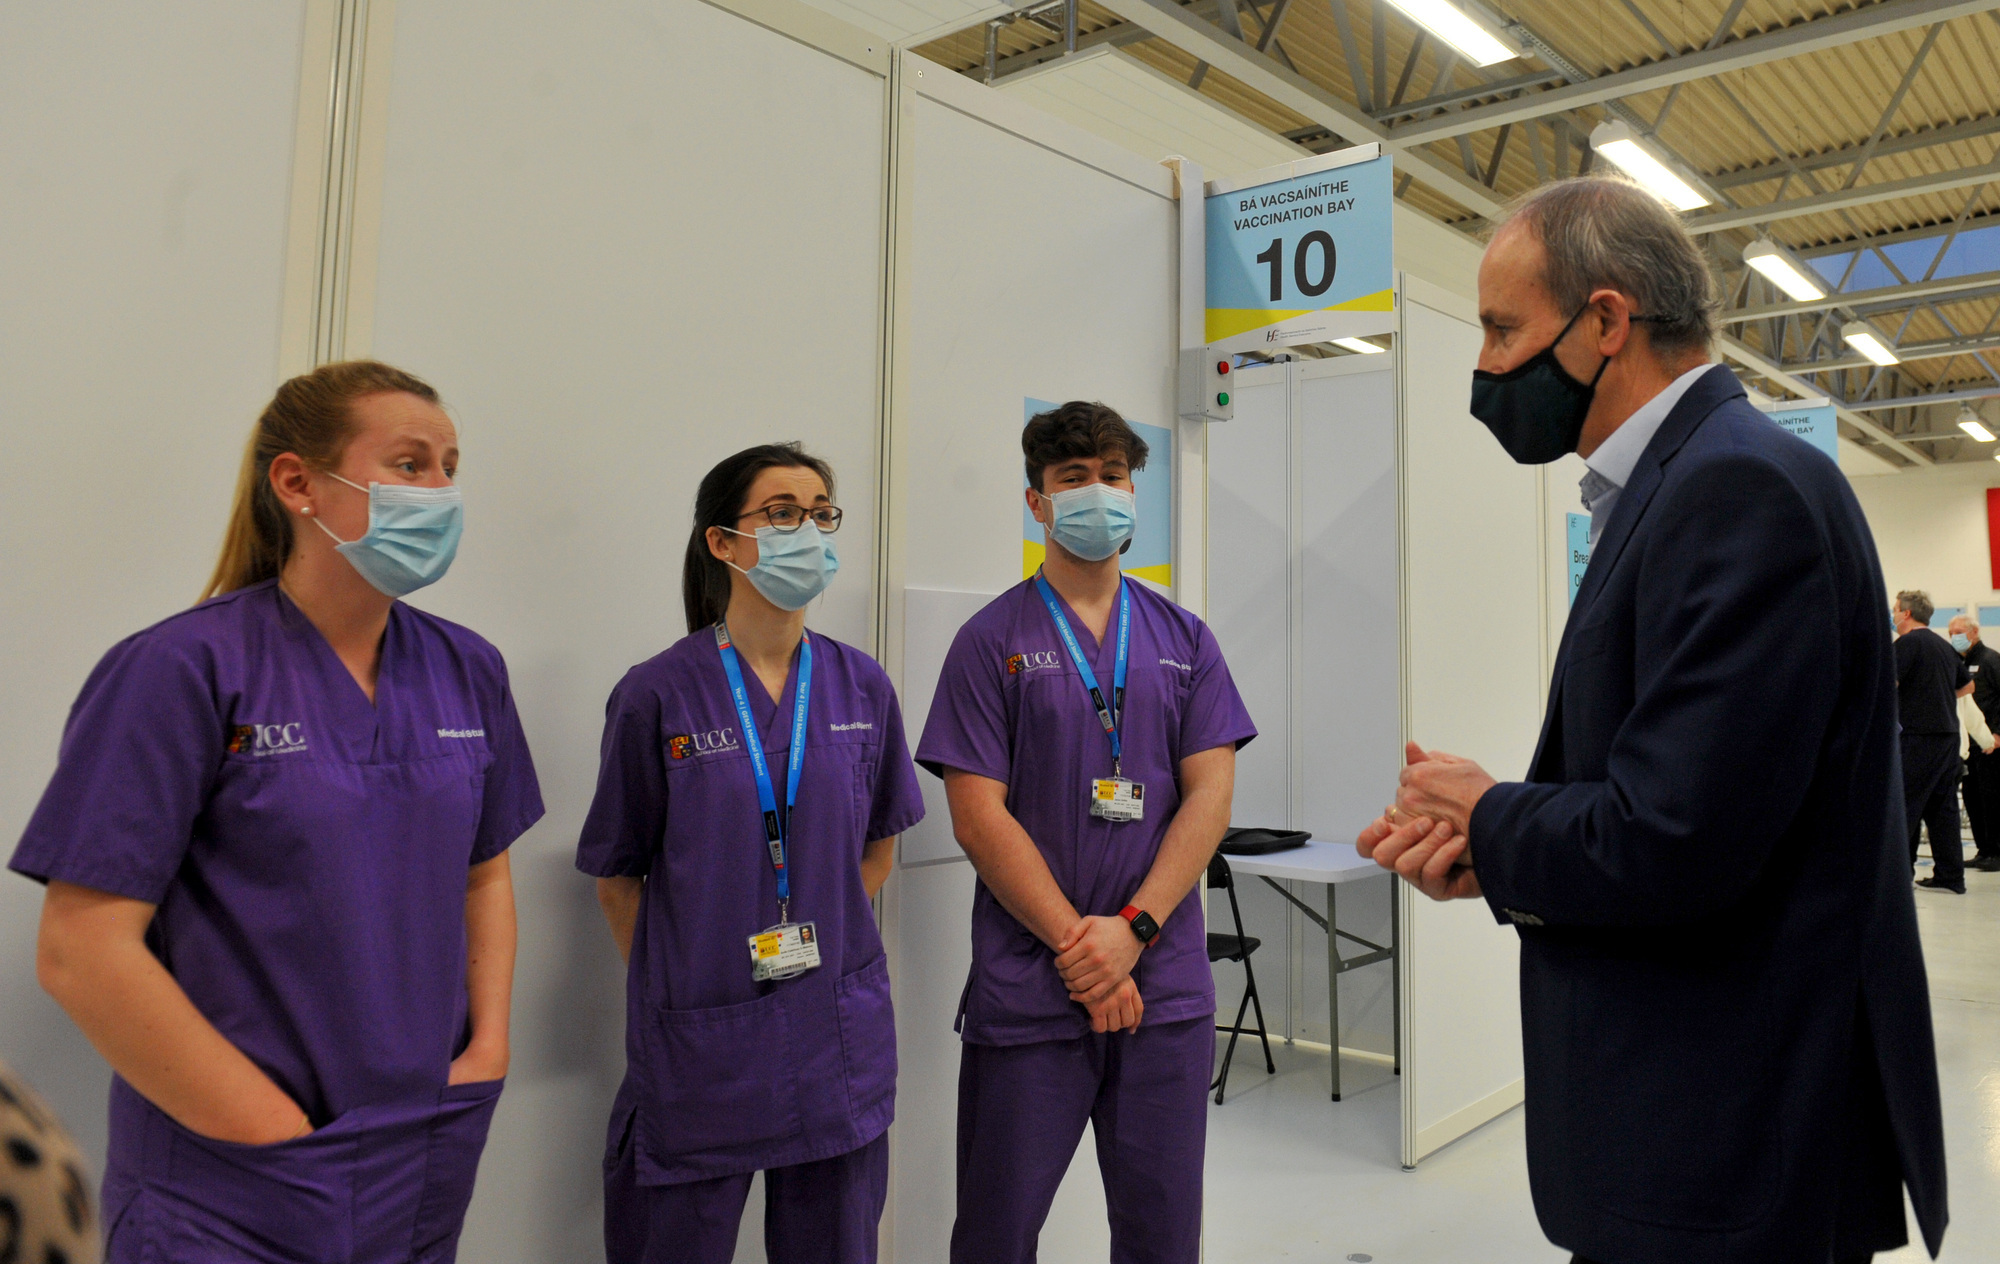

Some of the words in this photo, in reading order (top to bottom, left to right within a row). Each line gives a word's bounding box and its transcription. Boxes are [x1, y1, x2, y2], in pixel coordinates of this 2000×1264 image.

[1240, 195, 1257, 212] BÁ
[1261, 180, 1349, 208] VACSAÍNÍTHE
[1234, 204, 1324, 231] VACCINATION
[1328, 198, 1356, 213] BAY
[1256, 230, 1337, 302] 10
[1797, 426, 1815, 434] BAY
[1022, 650, 1059, 668] UCC
[692, 727, 738, 751] UCC
[735, 686, 743, 700] Year
[746, 728, 759, 754] Medical
[753, 752, 764, 777] Student
[794, 722, 803, 747] Medical
[792, 746, 801, 771] Student
